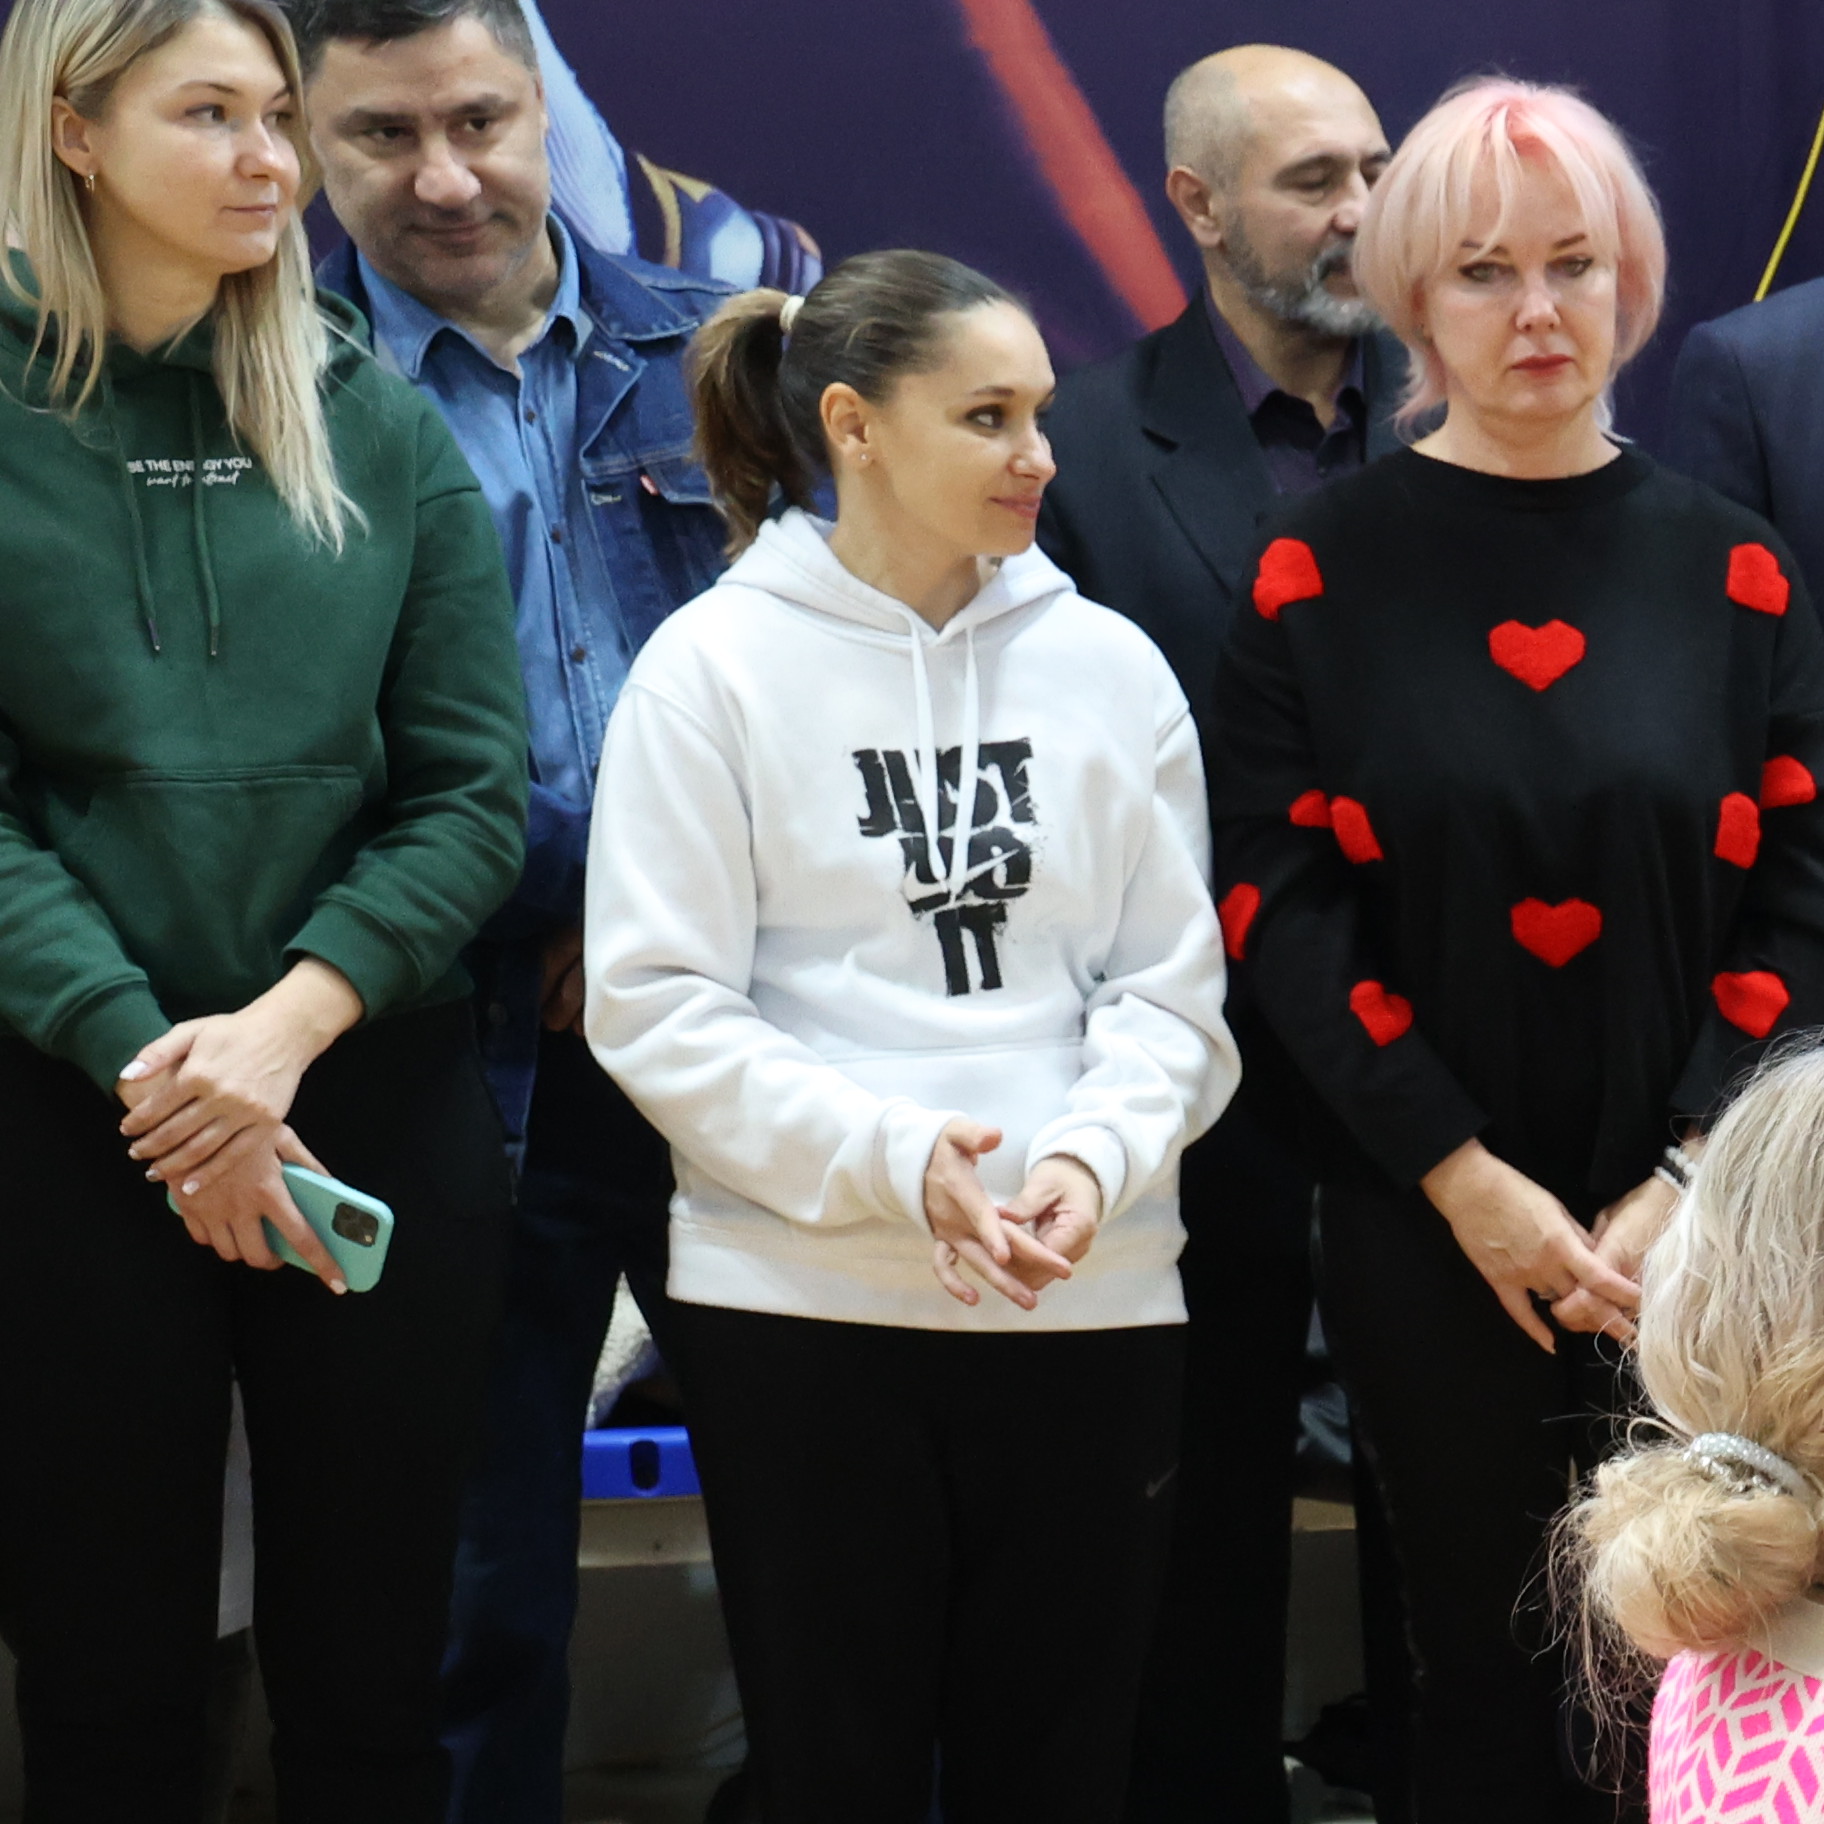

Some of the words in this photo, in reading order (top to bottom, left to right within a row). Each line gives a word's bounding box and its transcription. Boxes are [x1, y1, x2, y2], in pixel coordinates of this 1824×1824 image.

[145, 459, 172, 472] THE
[222, 457, 252, 470] YOU
[851, 737, 1033, 838] JUST
[933, 900, 1008, 997] IT
